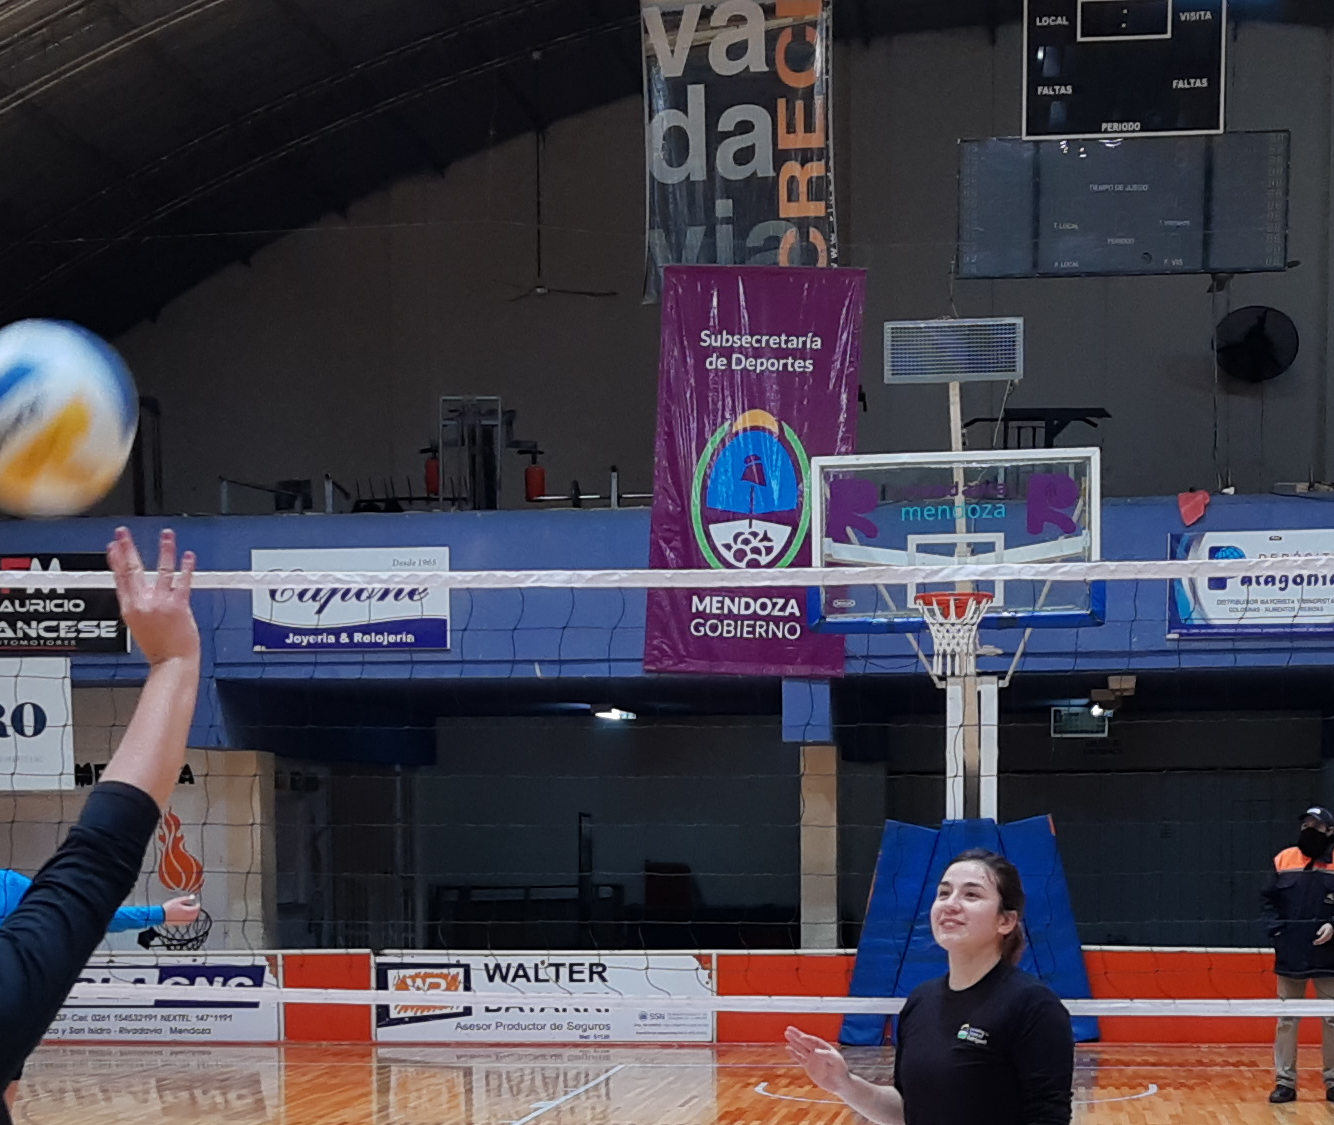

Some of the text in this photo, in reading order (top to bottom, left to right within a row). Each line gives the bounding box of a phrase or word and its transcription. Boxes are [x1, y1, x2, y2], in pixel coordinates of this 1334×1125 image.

[1036, 16, 1069, 26] LOCAL
[1179, 11, 1212, 22] VISITA
[641, 0, 769, 78] va
[1172, 78, 1208, 89] FALTAS
[1037, 85, 1073, 95] FALTAS
[1101, 122, 1141, 132] PERIODO
[646, 84, 777, 185] da
[700, 330, 822, 351] Subsecretaría
[706, 353, 814, 373] de Deportes
[901, 501, 1007, 522] mendoza
[691, 596, 801, 617] MENDOZA
[689, 619, 801, 641] GOBIERNO
[340, 633, 349, 644] &
[483, 962, 609, 984] WALTER
[91, 1013, 111, 1022] 0261
[68, 1026, 86, 1035] San
[87, 1026, 112, 1035] Isidro
[118, 1026, 163, 1035] Rivadavia
[170, 1026, 211, 1035] Mendoza
[454, 1021, 611, 1033] Asesor Productor de Seguros
